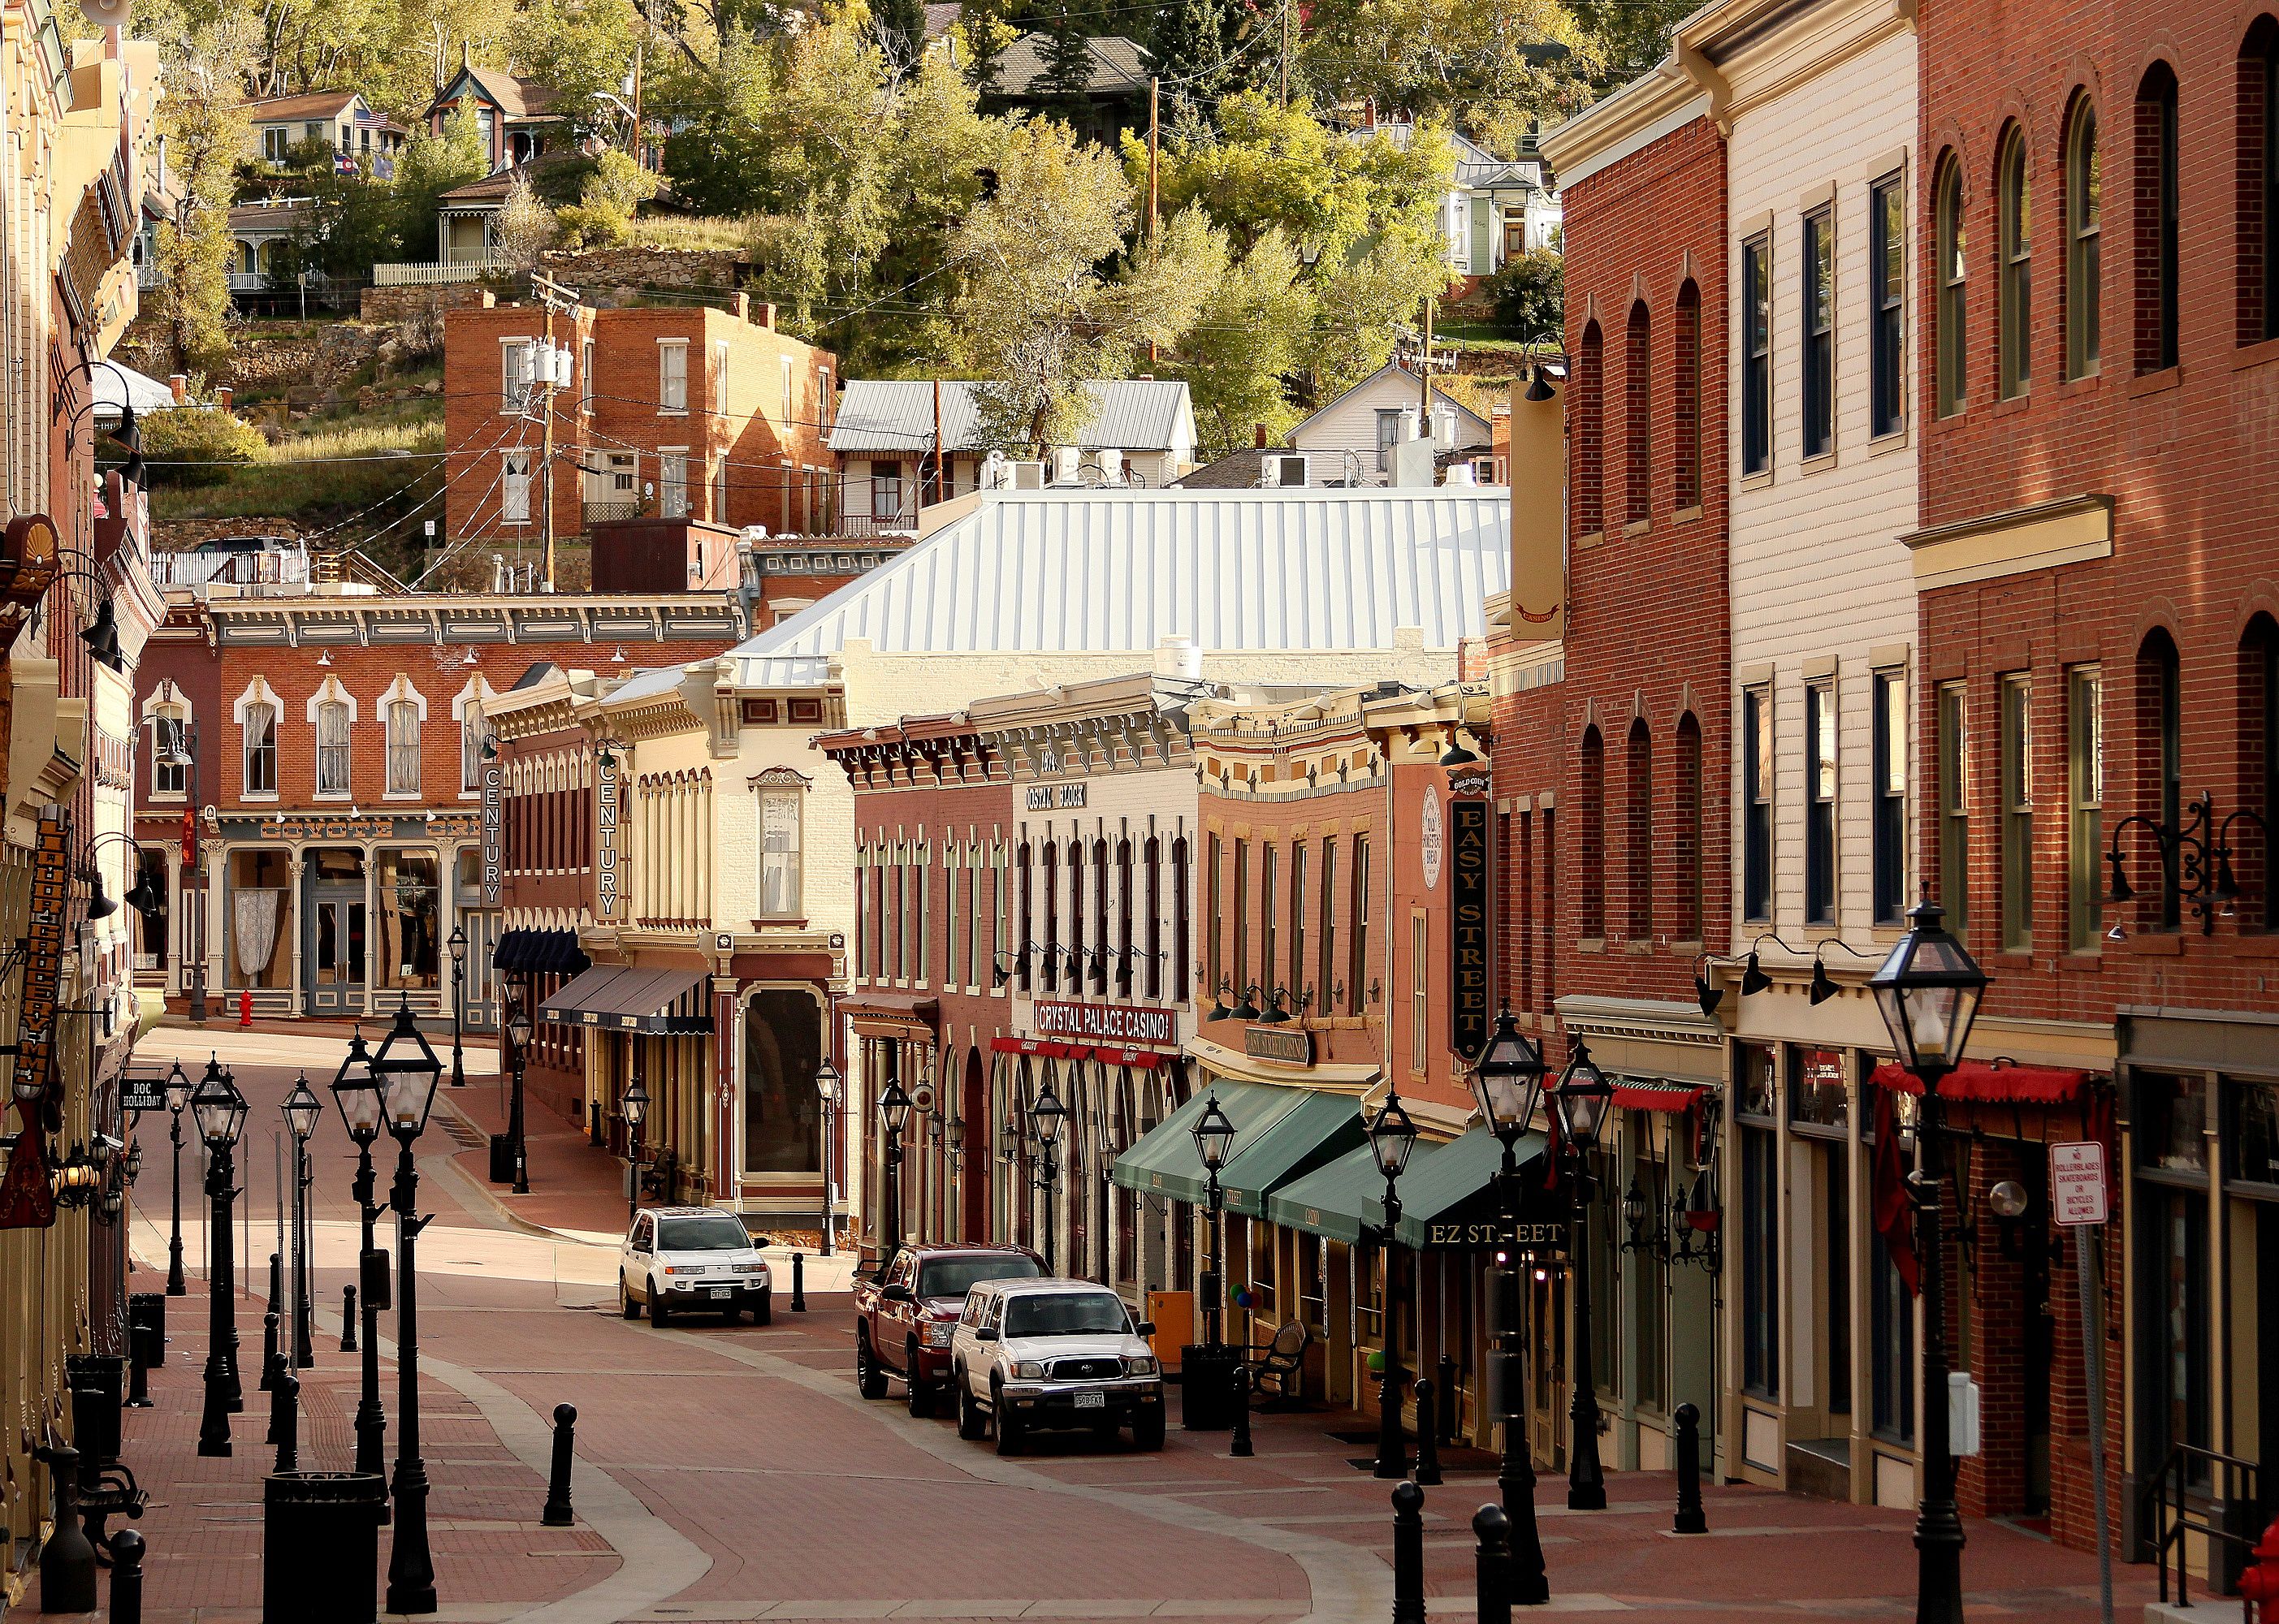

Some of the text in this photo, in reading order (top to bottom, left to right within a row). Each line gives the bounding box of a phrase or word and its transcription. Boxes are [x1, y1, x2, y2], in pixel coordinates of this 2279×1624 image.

[1523, 612, 1551, 621] CASINO
[1454, 777, 1485, 789] GOLD COIN
[1059, 784, 1084, 807] BLOCK
[1459, 787, 1481, 796] SALOON
[260, 821, 394, 839] COYOTE
[485, 769, 500, 903] CENTURY
[599, 763, 617, 915] CENTURY
[1458, 811, 1485, 1031] EASY STREET
[15, 818, 72, 1086] LIQUOR GROCERY MMJ
[1039, 1005, 1165, 1040] CRYSTAL PALACE CASINO
[133, 1082, 151, 1095] DOC
[123, 1095, 162, 1107] HOLLIDAY
[2054, 1162, 2100, 1172] ROLLERBLADES
[2058, 1173, 2098, 1183] SKATEBOARDS
[2075, 1185, 2084, 1193] OR
[1226, 1188, 1243, 1207] STREET
[2065, 1195, 2094, 1204] BICYCLES
[2067, 1206, 2095, 1216] ALLOWED
[1430, 1224, 1461, 1243] EZ
